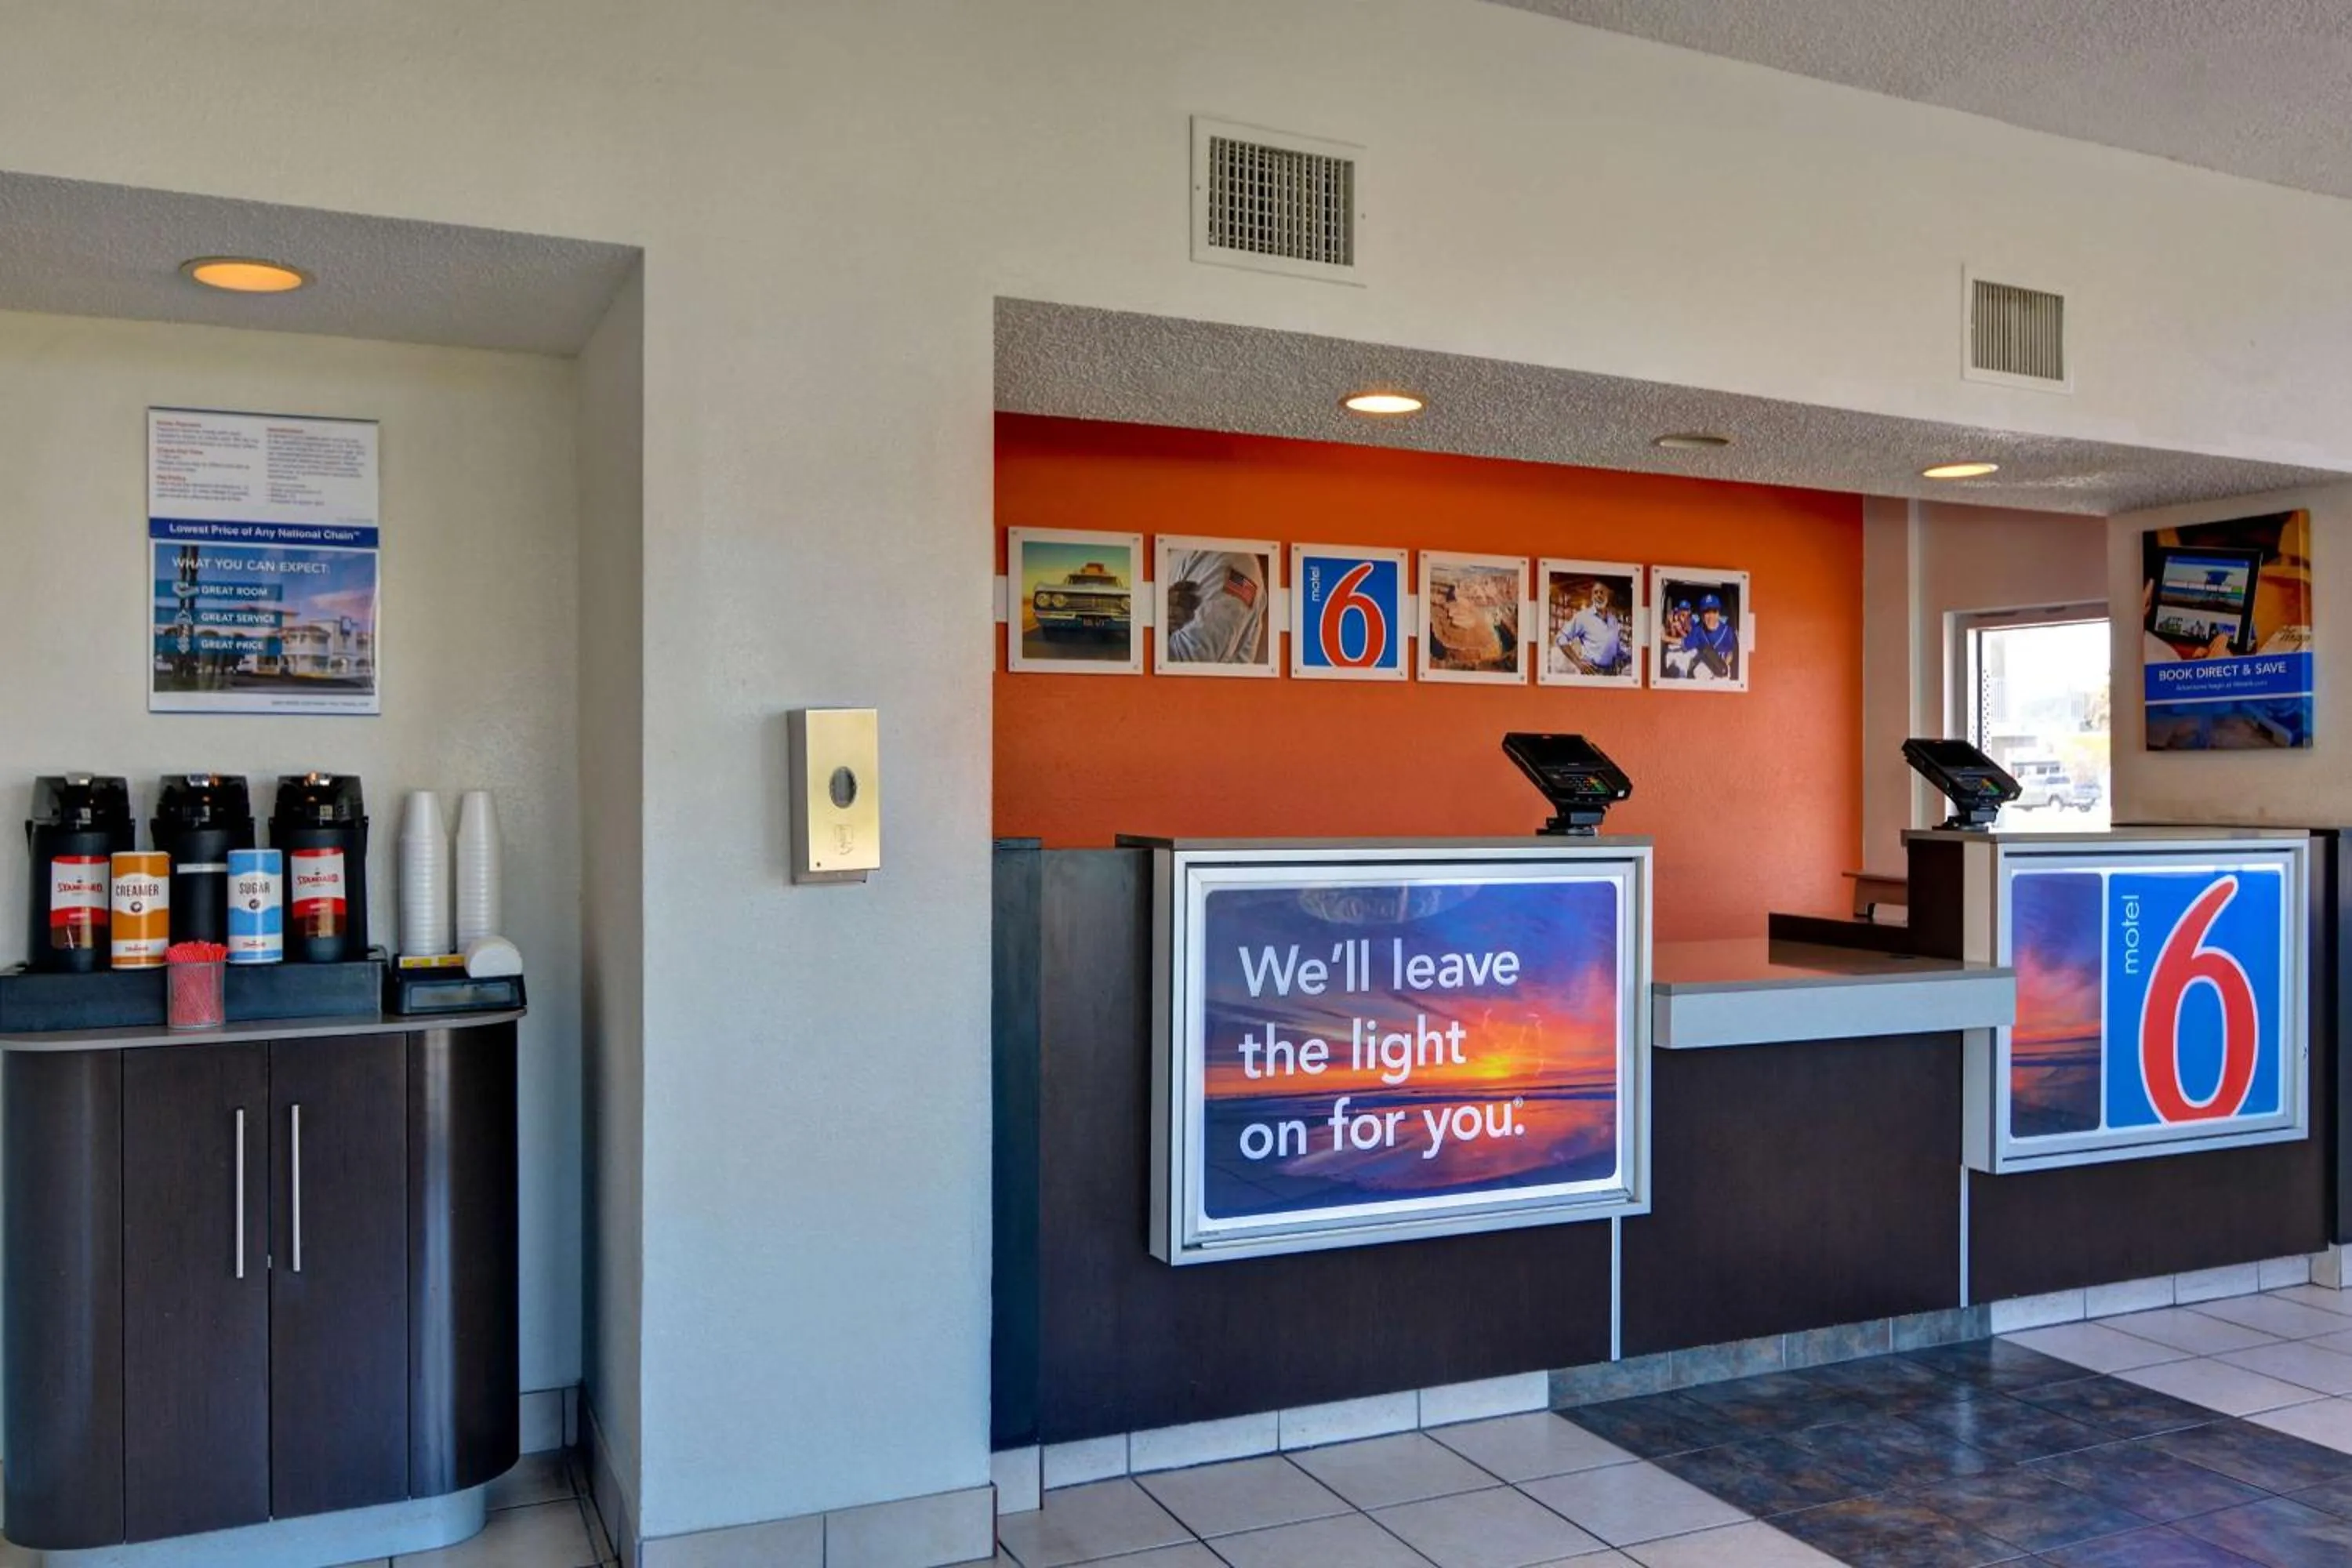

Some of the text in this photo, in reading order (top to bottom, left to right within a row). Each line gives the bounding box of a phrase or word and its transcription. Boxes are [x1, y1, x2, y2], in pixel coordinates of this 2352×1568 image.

[169, 523, 209, 534] Lowest
[211, 524, 239, 535] Price
[241, 526, 252, 536] of
[255, 526, 276, 539] Any
[278, 528, 321, 539] National
[172, 556, 212, 570] WHAT
[214, 557, 243, 571] YOU
[247, 559, 275, 572] CAN
[201, 585, 268, 596] GREAT ROOM
[201, 612, 276, 624] GREAT SERVICE
[1309, 562, 1387, 668] motel 6
[201, 639, 264, 652] GREAT PRICE
[2158, 661, 2287, 681] BOOK DIRECT & SAVE
[115, 884, 159, 897] CREAMER
[238, 881, 271, 895] SUGAR
[1238, 937, 1521, 998] We'll leave
[2121, 874, 2260, 1127] motel 6
[1238, 1013, 1468, 1086] the light
[1239, 1118, 1308, 1160] on
[1327, 1097, 1406, 1152] for
